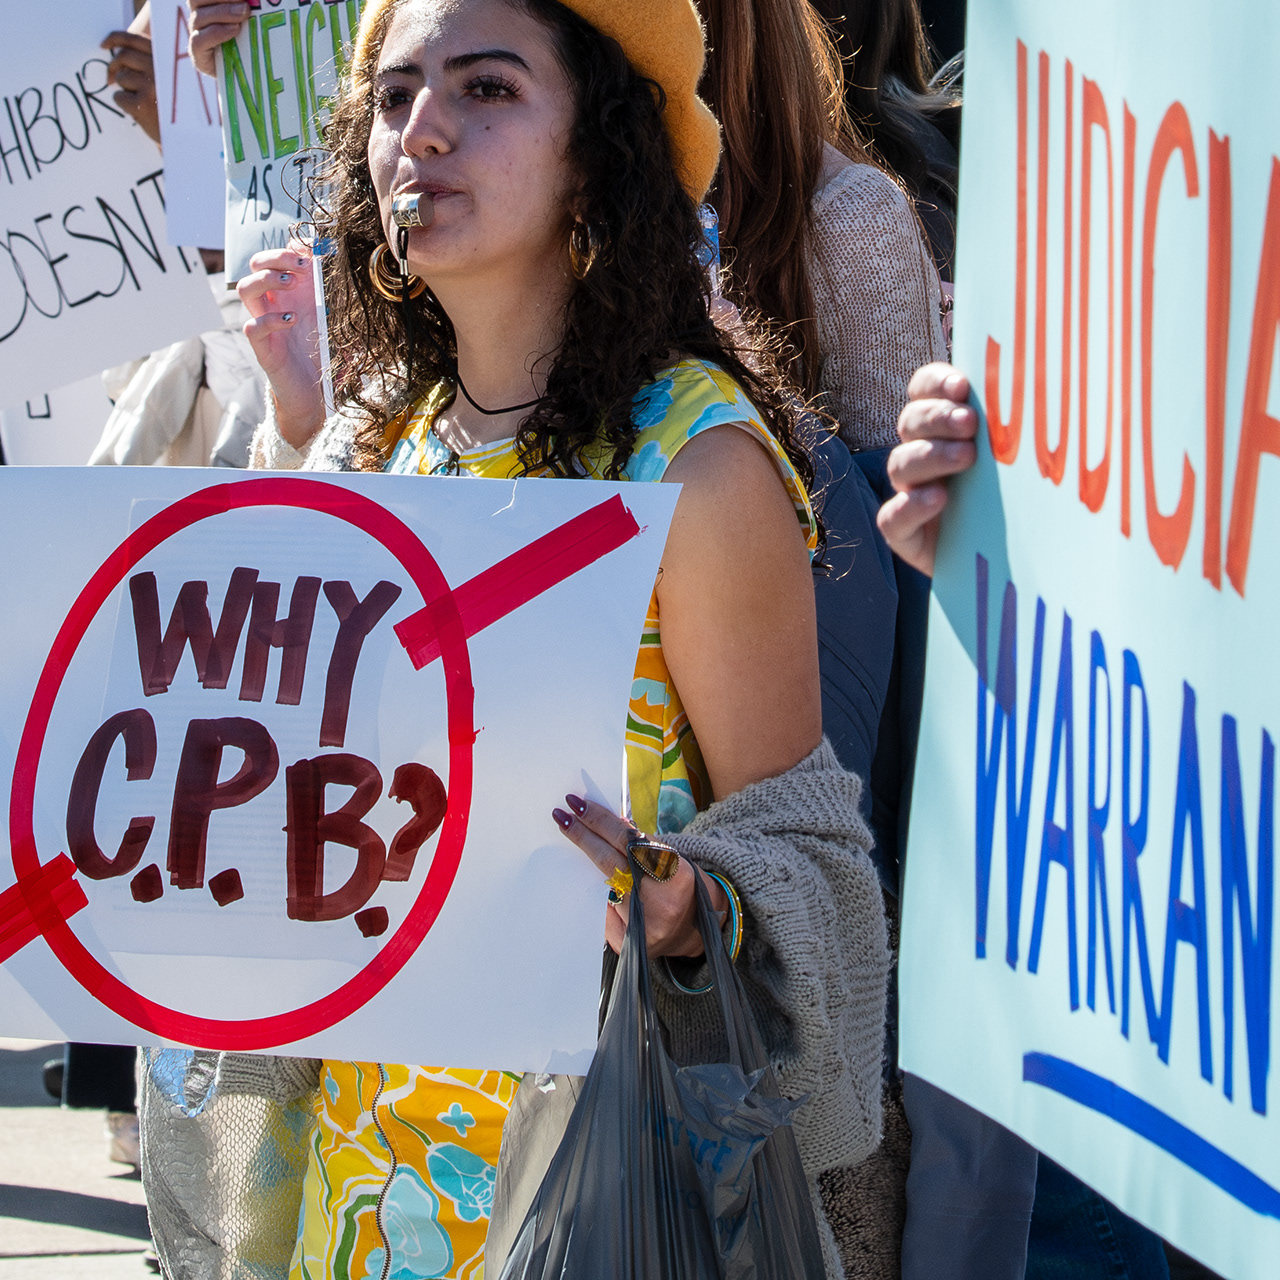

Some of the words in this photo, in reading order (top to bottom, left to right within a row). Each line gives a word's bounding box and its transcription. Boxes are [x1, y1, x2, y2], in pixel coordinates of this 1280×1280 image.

[241, 164, 273, 225] AS
[129, 565, 403, 747] WHY
[65, 707, 449, 938] C.P.B?
